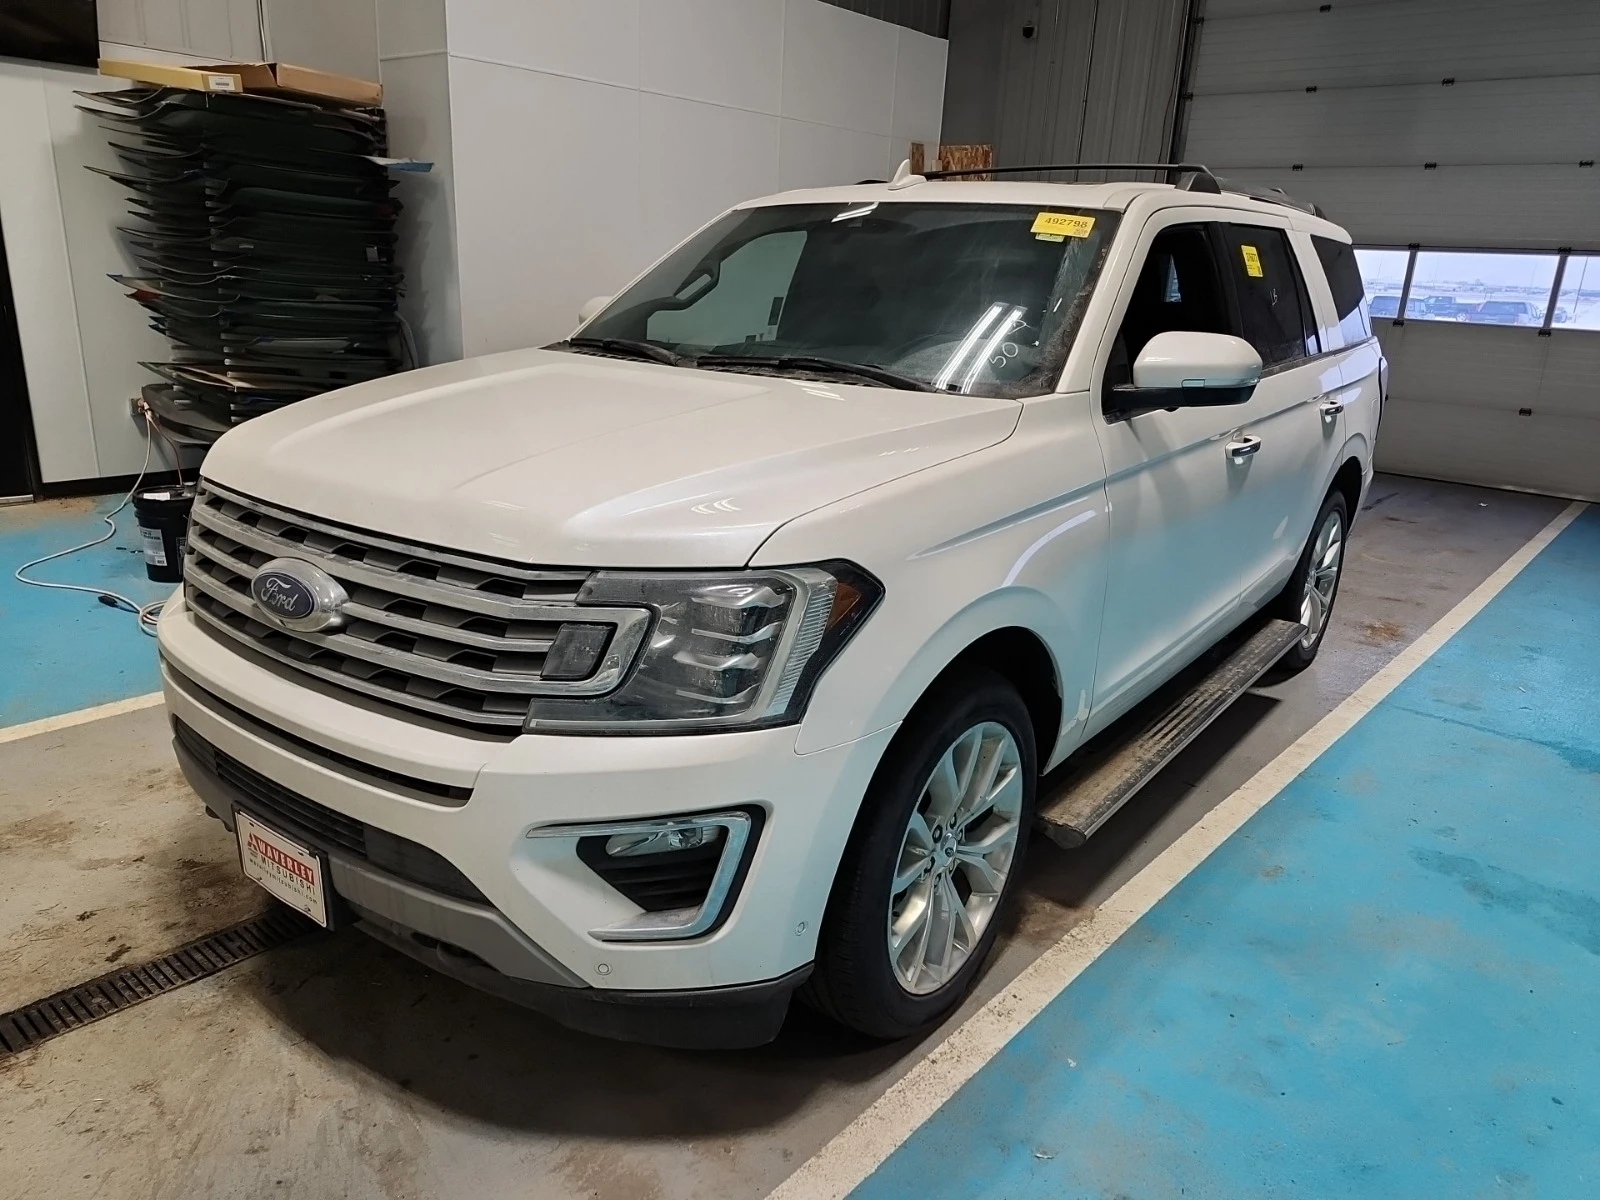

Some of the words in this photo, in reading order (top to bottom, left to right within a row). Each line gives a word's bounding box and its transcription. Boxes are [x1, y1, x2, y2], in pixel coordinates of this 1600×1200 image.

[1044, 217, 1088, 228] 492798
[261, 578, 298, 611] Ford
[257, 838, 314, 882] WAVERLEY
[260, 855, 316, 895] MITSUBISHI
